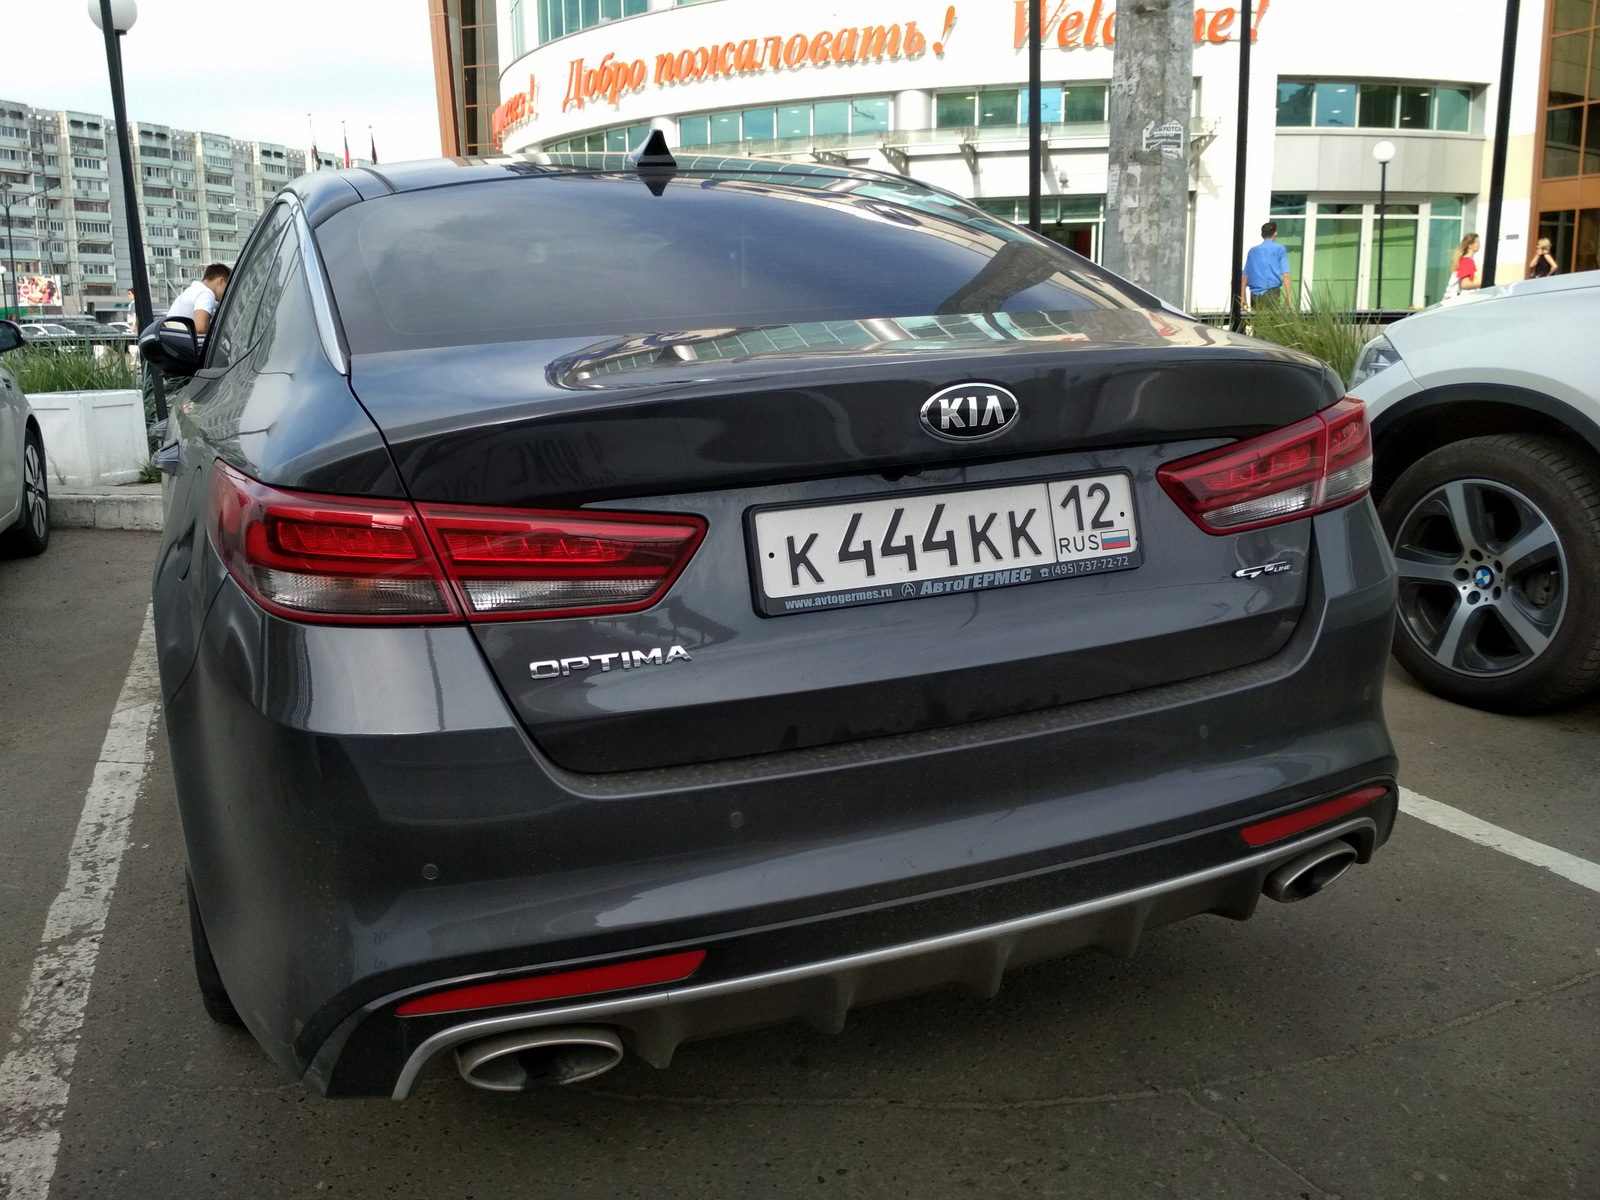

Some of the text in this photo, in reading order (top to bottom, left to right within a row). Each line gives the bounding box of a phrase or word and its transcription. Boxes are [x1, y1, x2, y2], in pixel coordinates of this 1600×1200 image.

[562, 5, 956, 112] Добро пожаловать!
[938, 394, 1006, 430] KIA
[1059, 482, 1115, 531] 12
[1058, 534, 1100, 555] RUS
[1051, 555, 1130, 577] (495) 737-72-72
[784, 587, 893, 610] www.avtogermes.ru
[528, 644, 693, 680] OPTIMA
